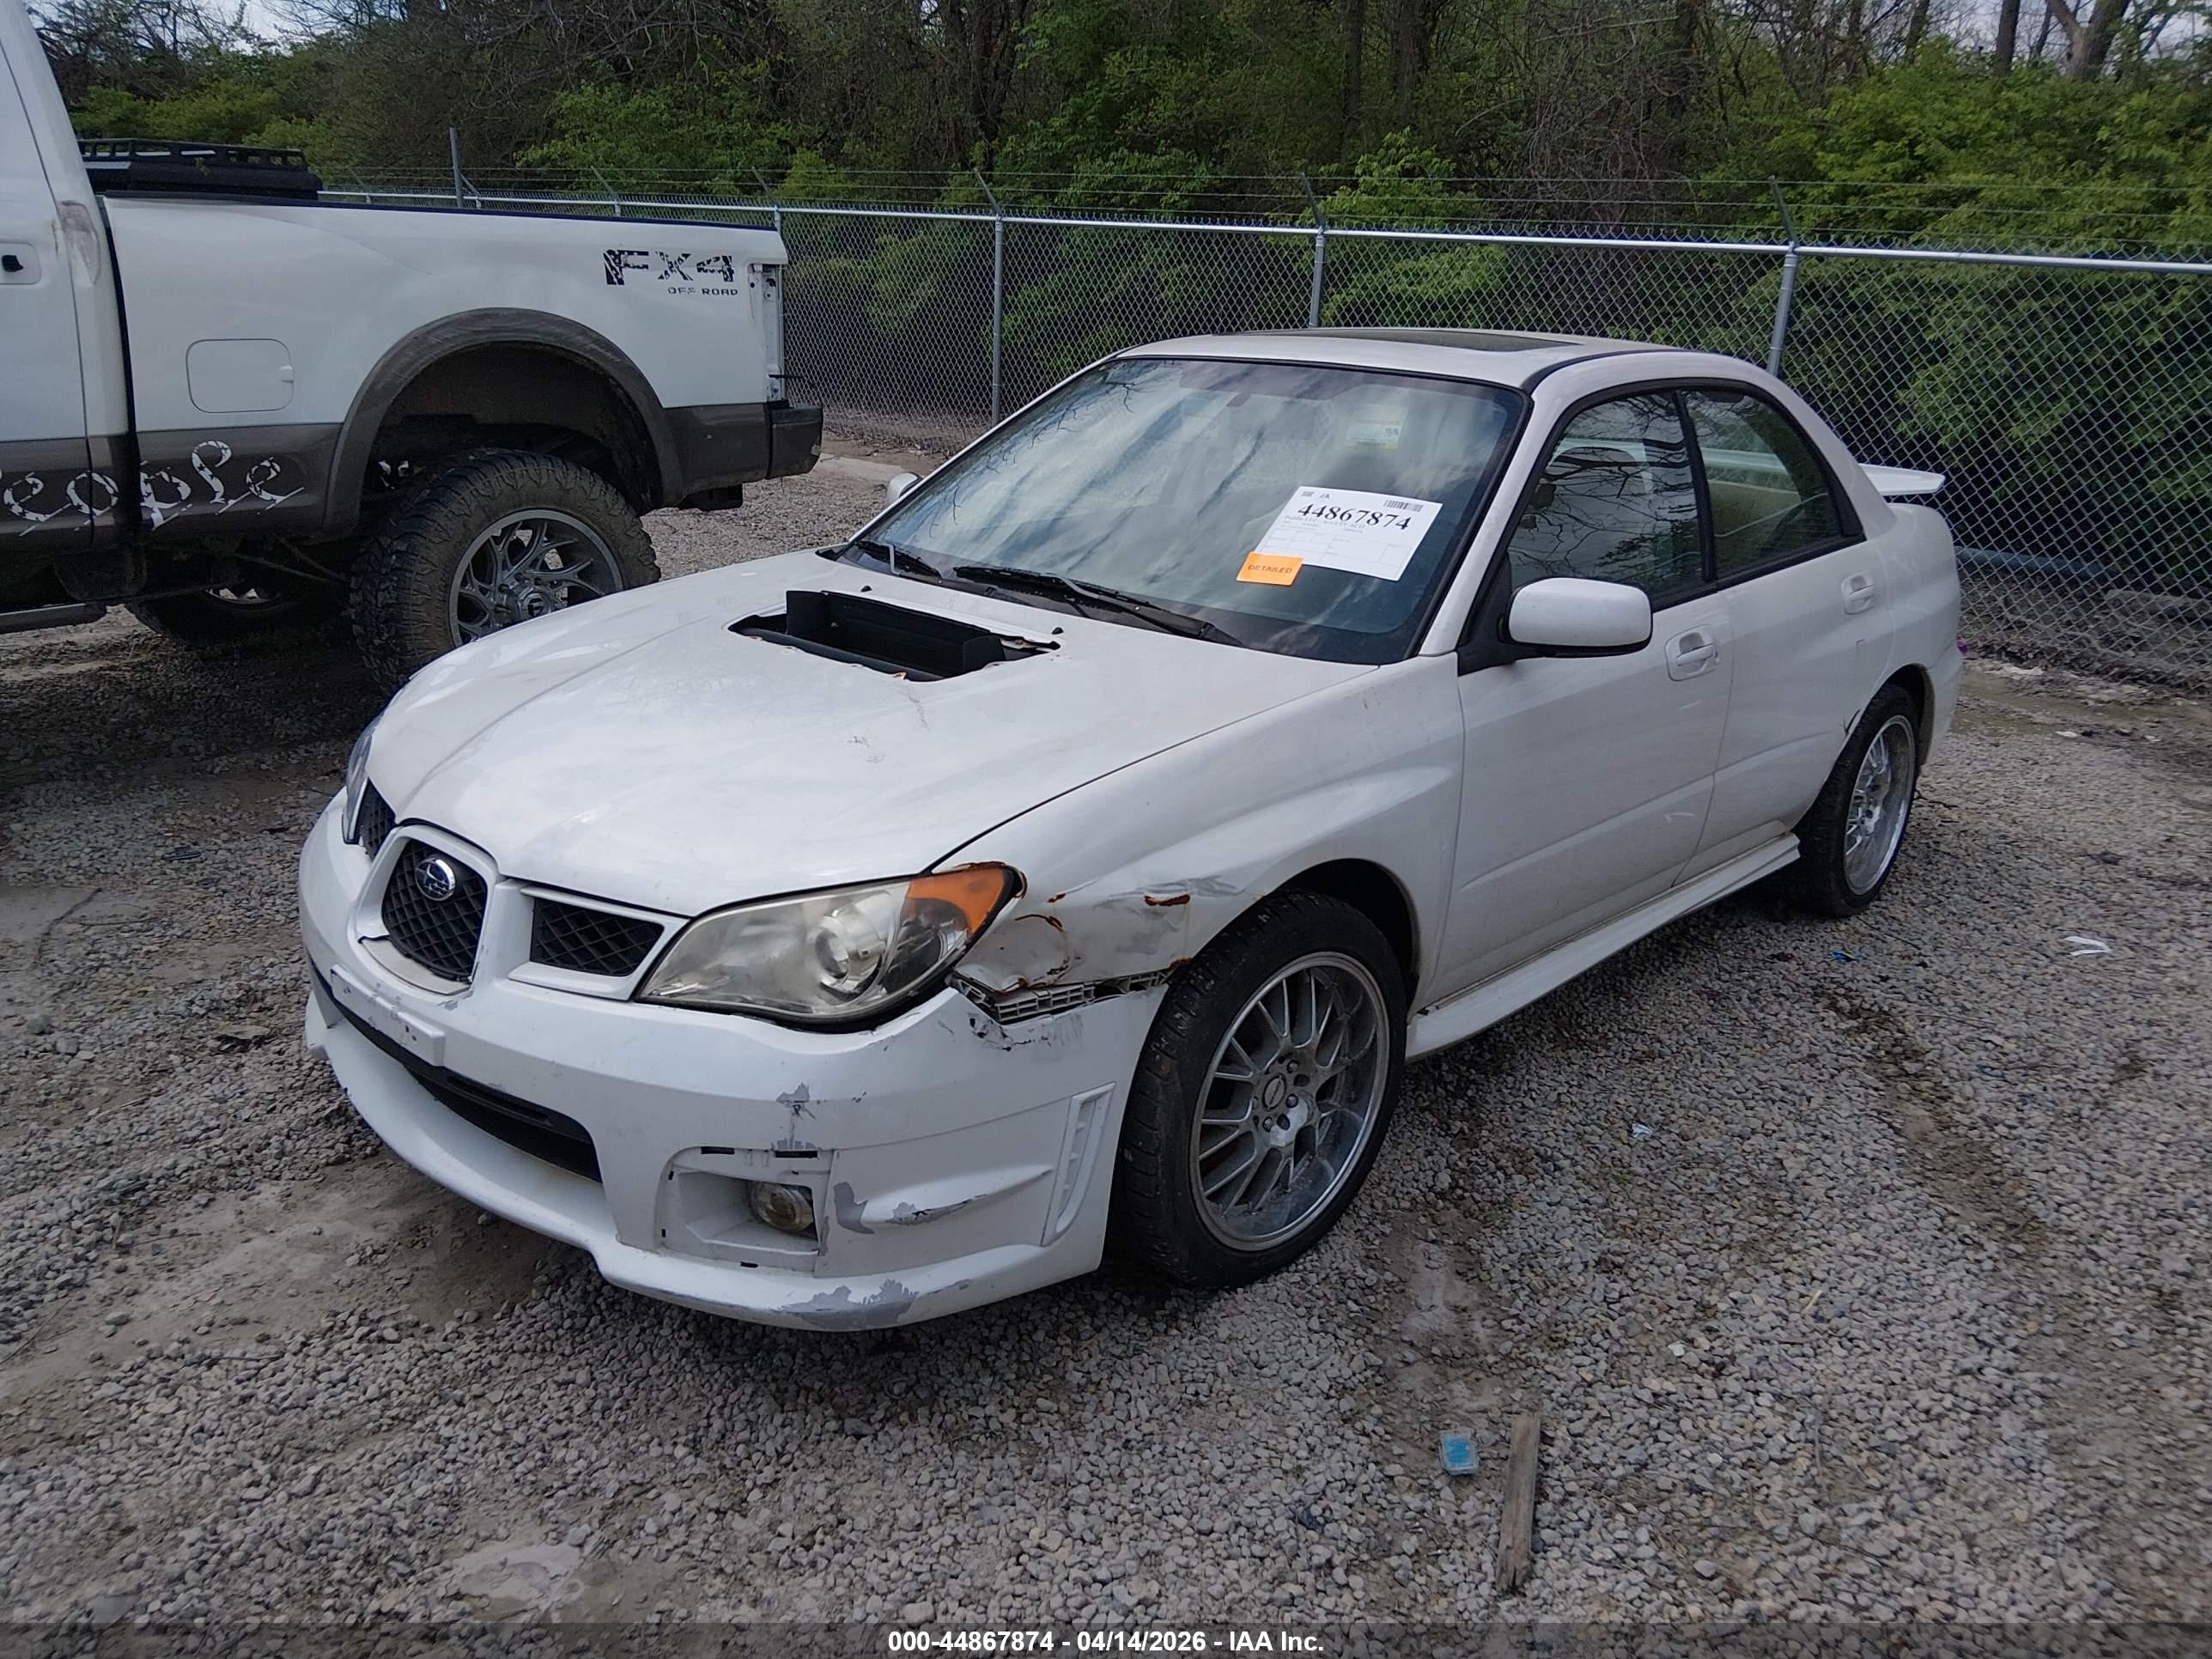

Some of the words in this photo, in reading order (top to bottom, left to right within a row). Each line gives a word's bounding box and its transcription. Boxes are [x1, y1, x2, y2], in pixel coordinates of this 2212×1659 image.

[603, 249, 735, 286] FX4
[667, 287, 696, 295] OFF
[702, 288, 738, 296] ROAD
[0, 440, 305, 536] eople
[1298, 504, 1411, 530] 44867874
[1248, 564, 1292, 574] DETAILED
